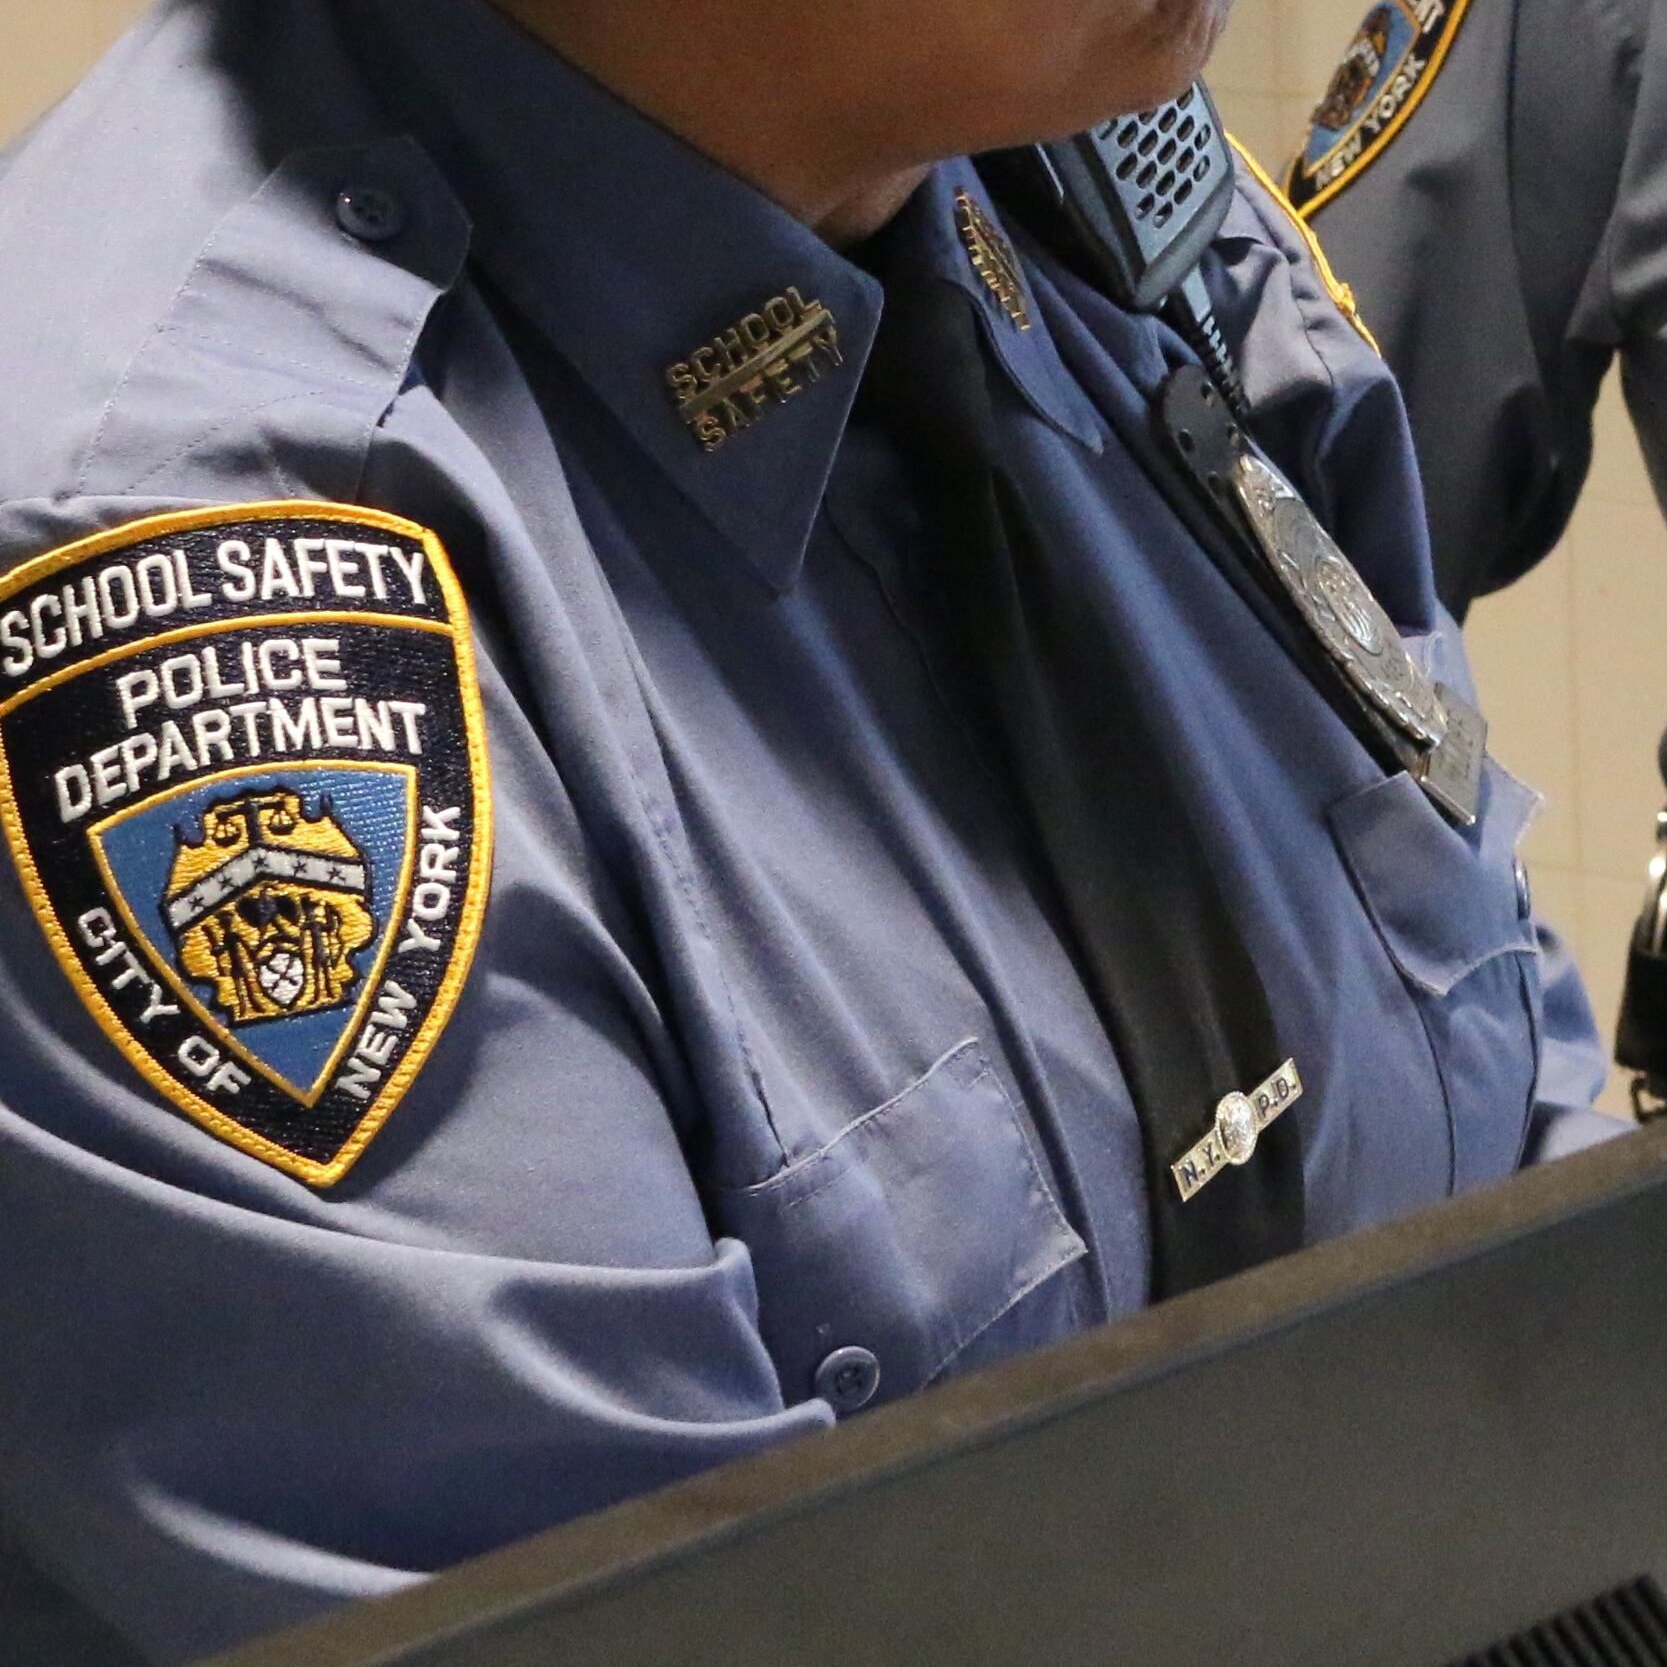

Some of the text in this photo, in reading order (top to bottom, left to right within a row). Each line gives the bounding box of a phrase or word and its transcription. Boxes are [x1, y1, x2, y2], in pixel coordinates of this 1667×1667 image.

[1364, 53, 1426, 133] YORK
[666, 285, 823, 401] SCHOOL
[1, 537, 427, 677] SCHOOL SAFETY
[115, 638, 348, 728] POLICE
[53, 697, 427, 824] DEPARTMENT
[77, 906, 252, 1097] CITY OF
[335, 804, 462, 1101] NEW YORK
[1180, 1076, 1297, 1188] N.Y. P.D.
